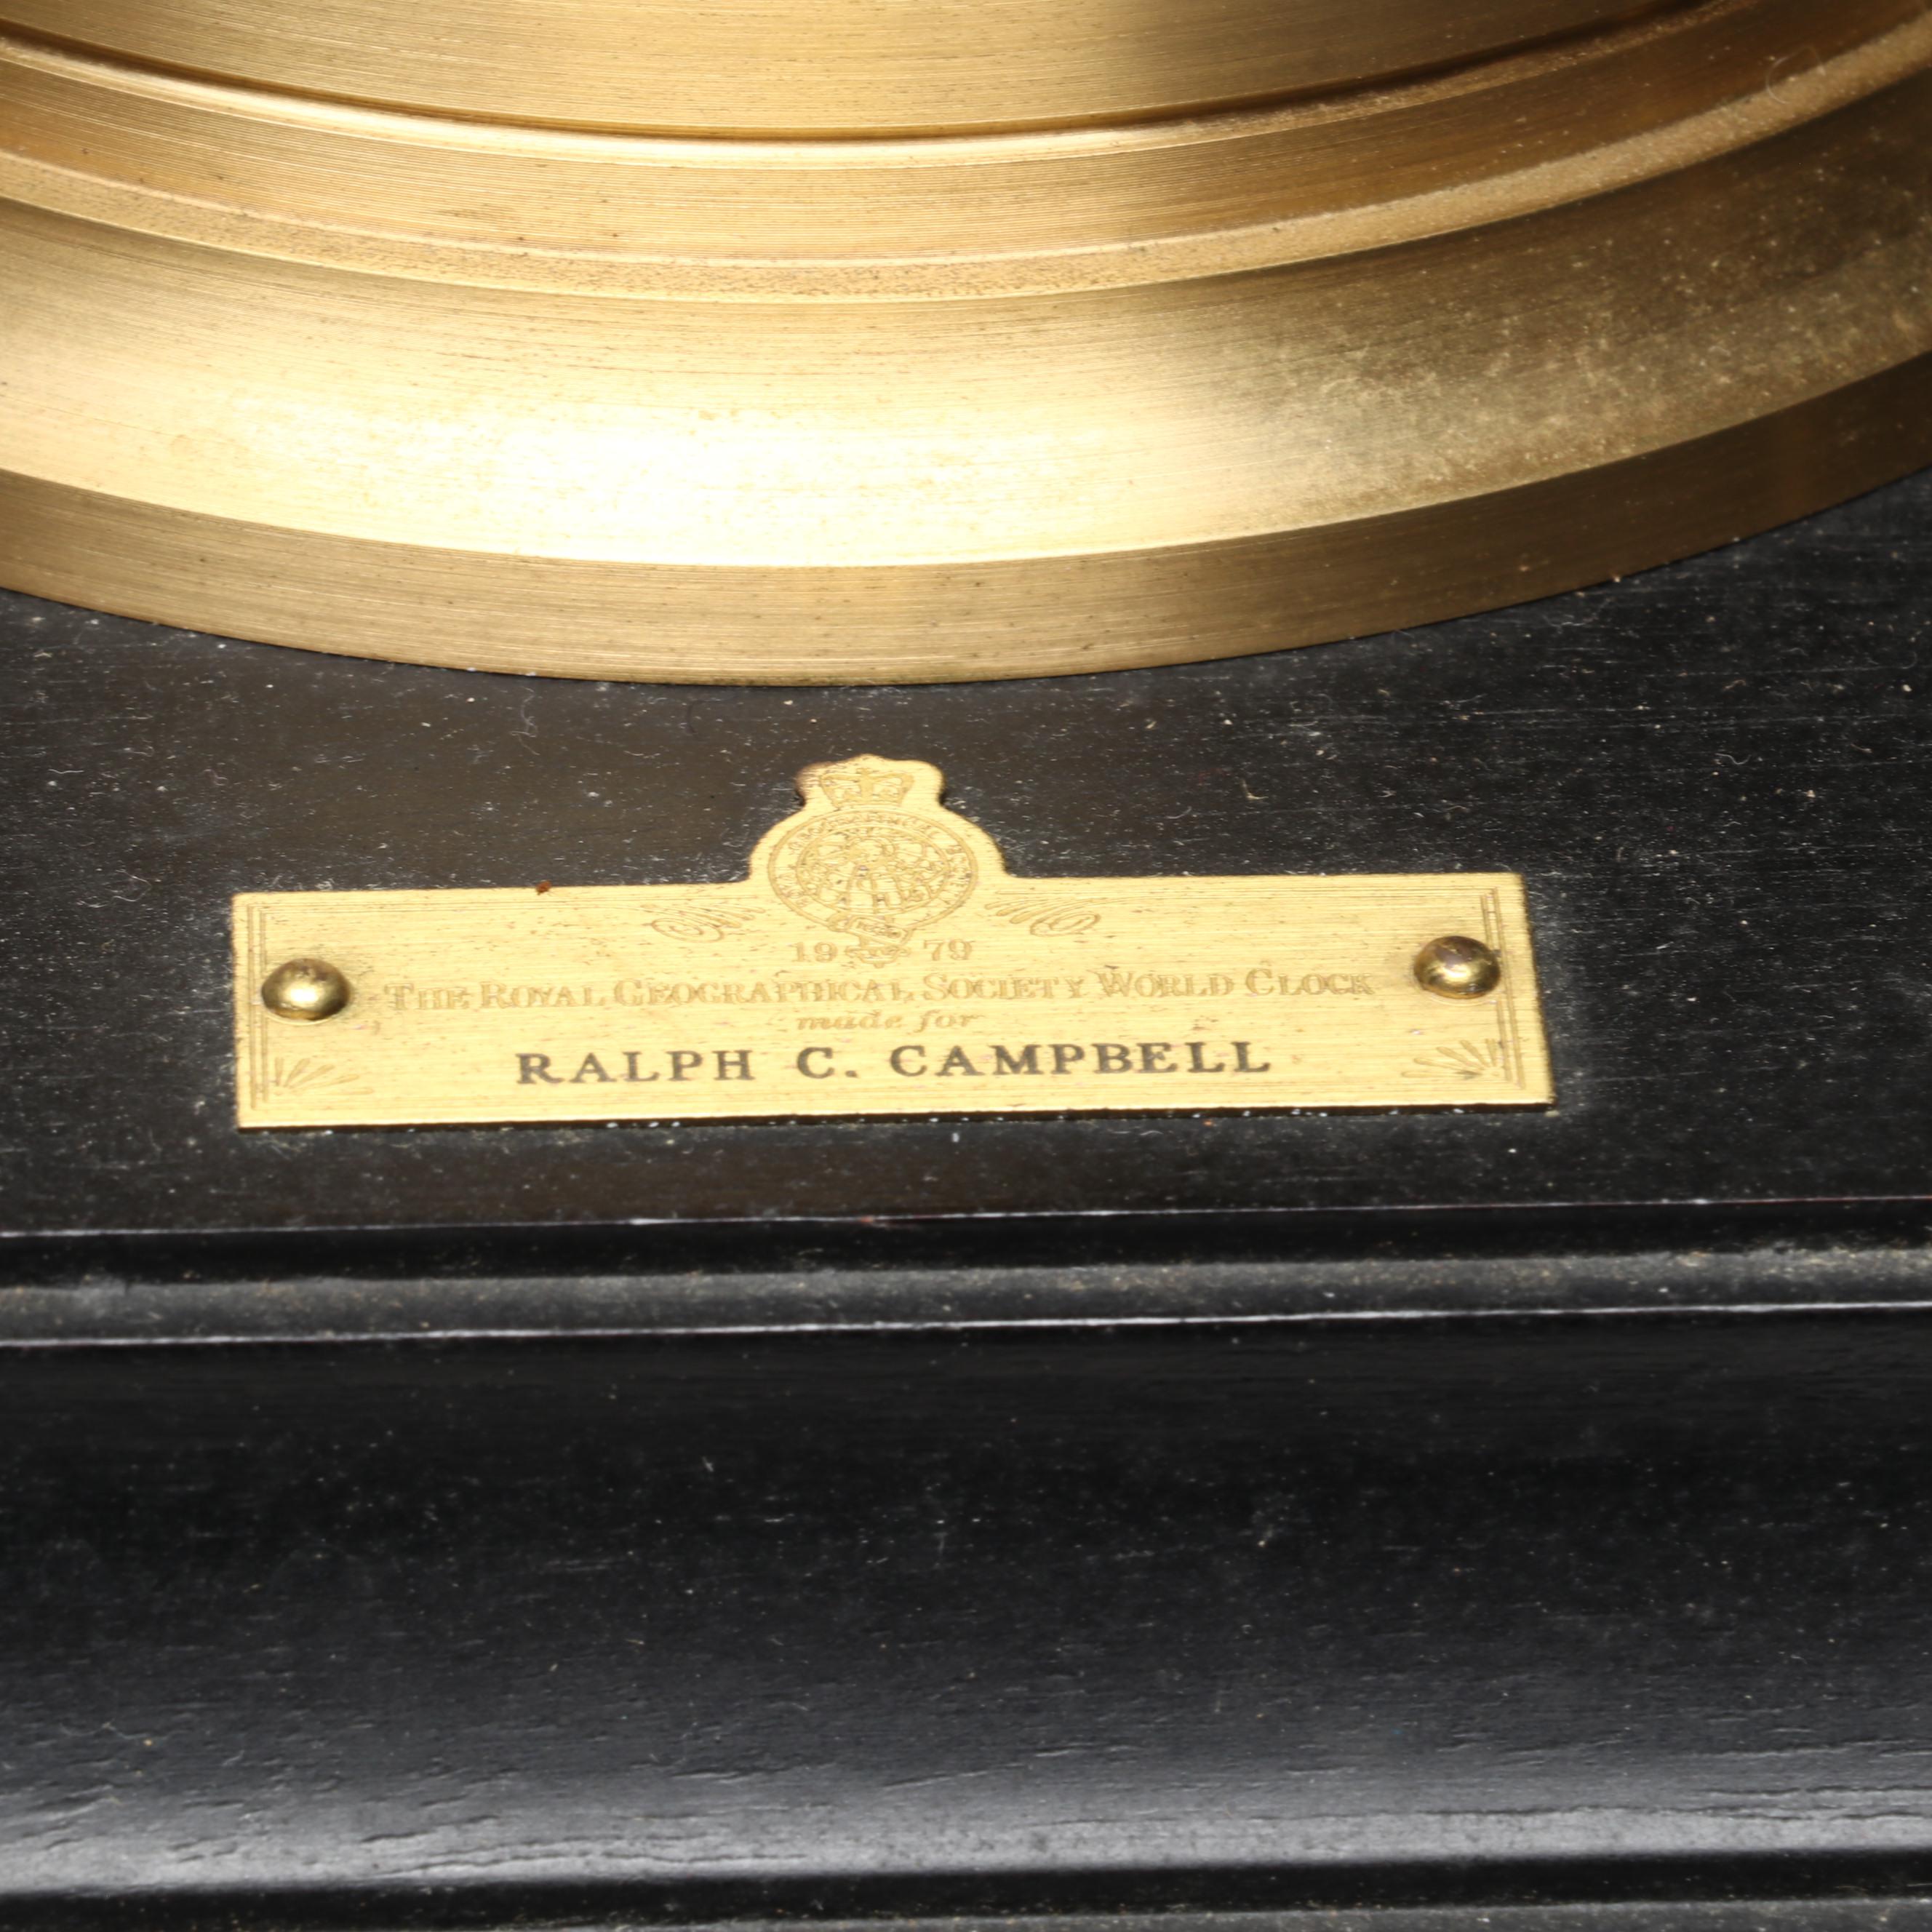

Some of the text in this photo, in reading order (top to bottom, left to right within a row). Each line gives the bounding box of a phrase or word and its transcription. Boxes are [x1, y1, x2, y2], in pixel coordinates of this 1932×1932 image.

[795, 942, 837, 962] 19
[385, 967, 1375, 1010] THE ROYAL GEOGRAPHICAL SOCIETY WORLD CLOCK
[797, 1009, 979, 1033] made for
[516, 1042, 1271, 1084] RALPH C. CAMPBELL
